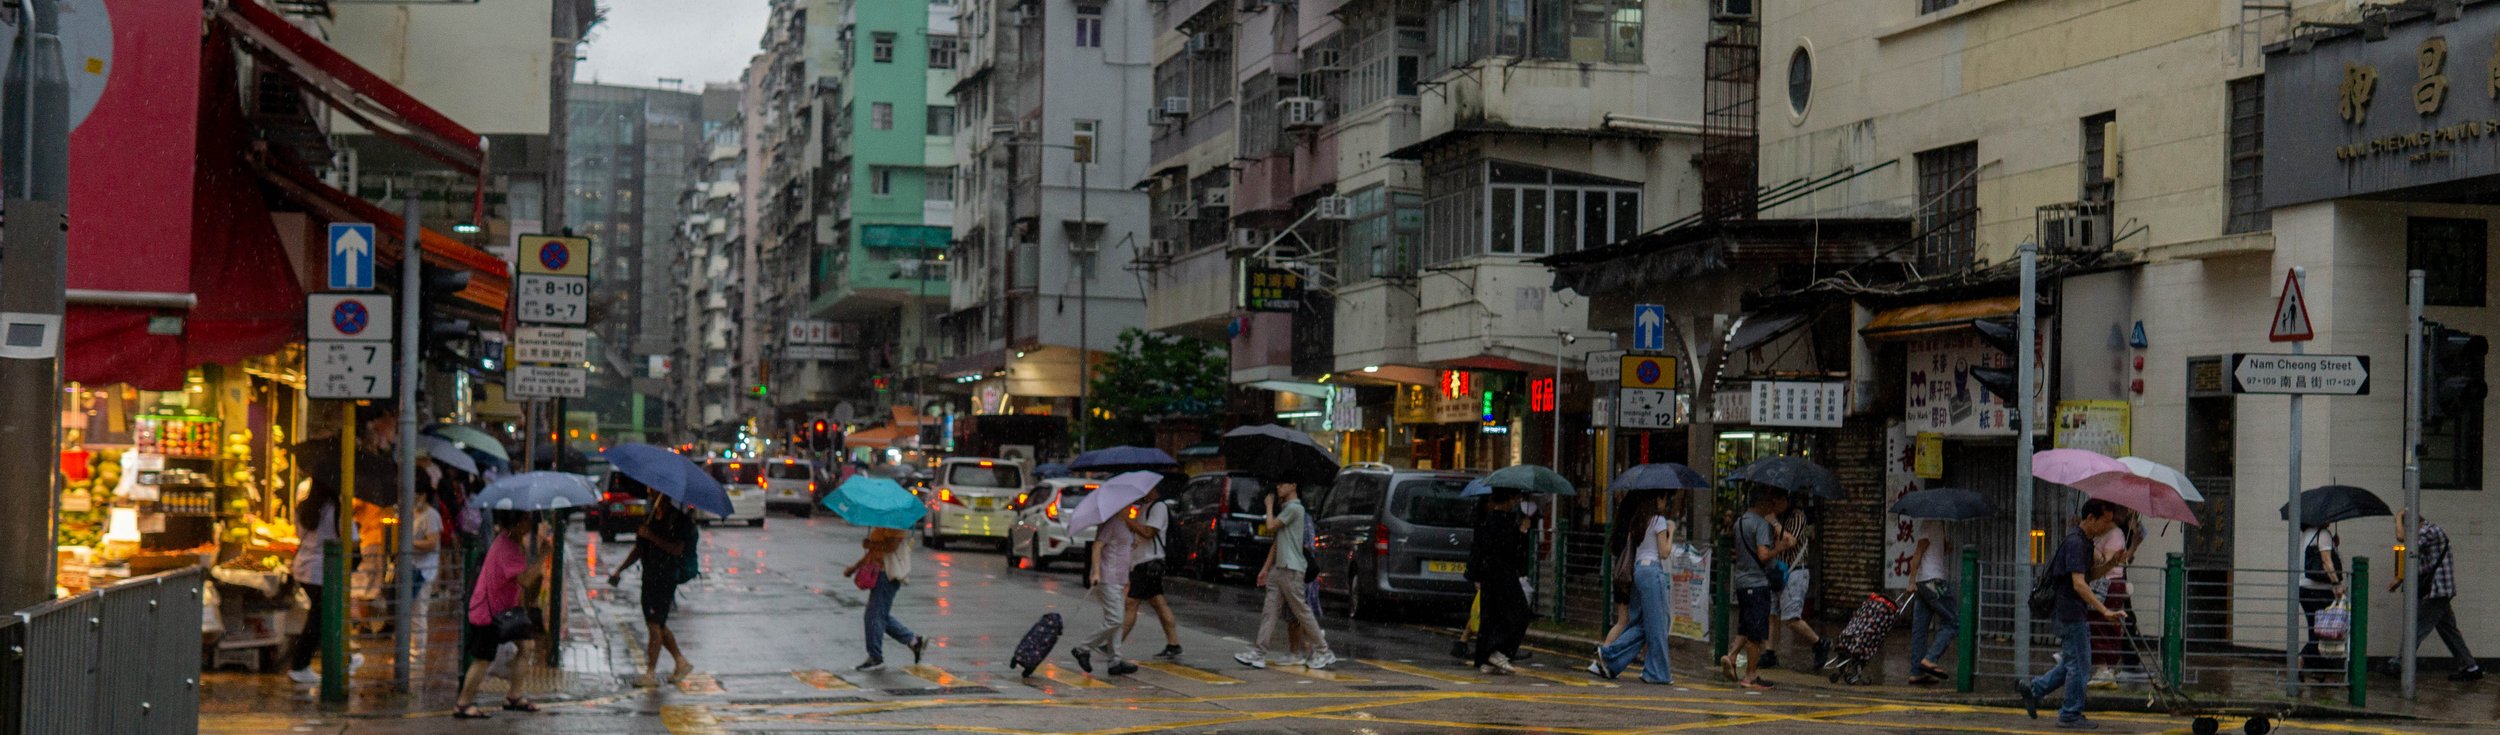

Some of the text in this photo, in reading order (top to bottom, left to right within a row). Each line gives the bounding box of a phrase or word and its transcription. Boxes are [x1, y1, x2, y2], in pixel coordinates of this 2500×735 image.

[2336, 143, 2366, 160] NAM
[2370, 130, 2431, 154] CHEONG
[2434, 120, 2480, 141] PAWN
[523, 286, 541, 295] 上午
[546, 282, 584, 296] 8-10
[522, 308, 540, 316] 下午
[327, 354, 348, 364] 上午
[363, 346, 376, 364] 7
[2250, 359, 2352, 372] Nam Cheong Street
[326, 383, 348, 393] 下午
[363, 376, 376, 393] 7
[2280, 375, 2322, 388] 南昌街
[1630, 396, 1646, 404] 上午
[1655, 392, 1665, 404] 7
[1655, 413, 1670, 426] 12
